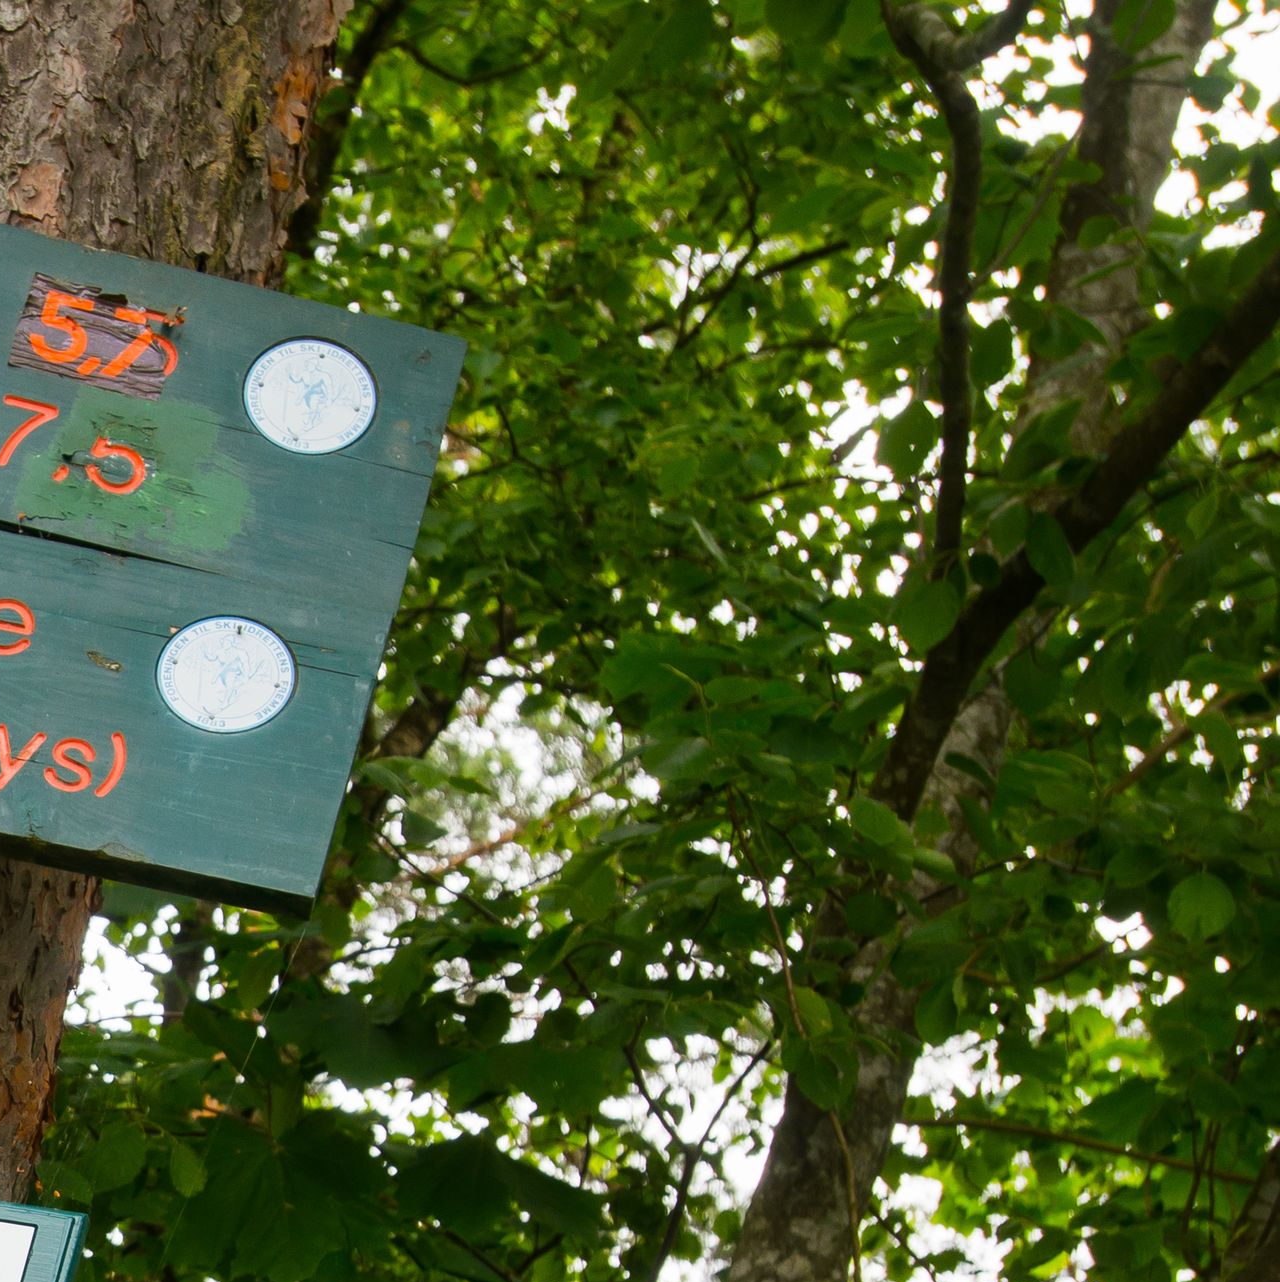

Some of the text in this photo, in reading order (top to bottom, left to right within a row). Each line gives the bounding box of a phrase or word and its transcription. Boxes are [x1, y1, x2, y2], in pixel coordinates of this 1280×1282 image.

[277, 348, 293, 359] TIL
[193, 624, 210, 636] TIL
[215, 621, 289, 673] SKIIDRETTENS
[255, 681, 288, 720] FREMME
